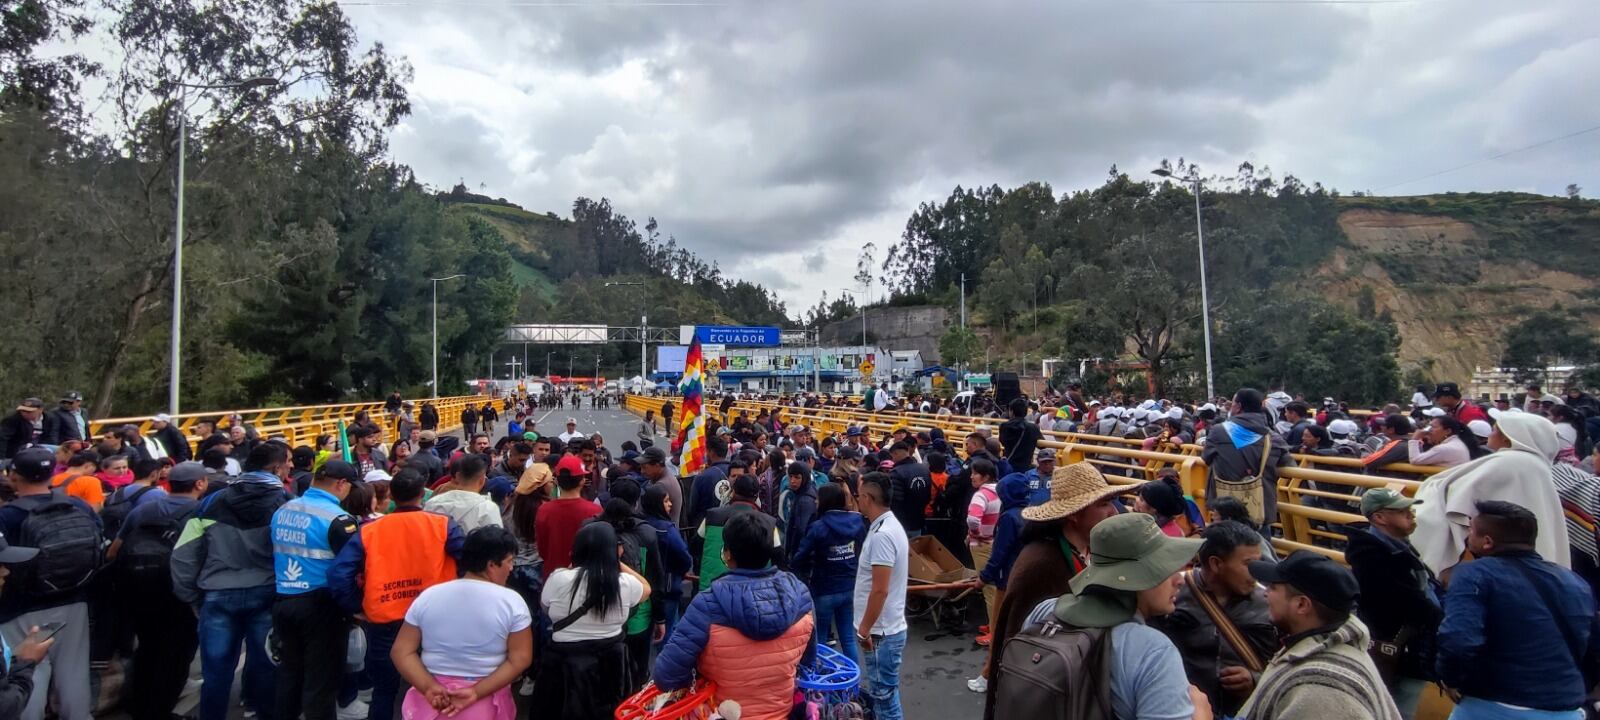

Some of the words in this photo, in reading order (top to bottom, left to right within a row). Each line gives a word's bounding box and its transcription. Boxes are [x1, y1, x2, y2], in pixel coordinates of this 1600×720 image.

[710, 334, 765, 343] ECUADOR
[276, 528, 306, 545] SPEAKER
[380, 593, 390, 603] DE
[392, 588, 422, 600] GOBIERN
